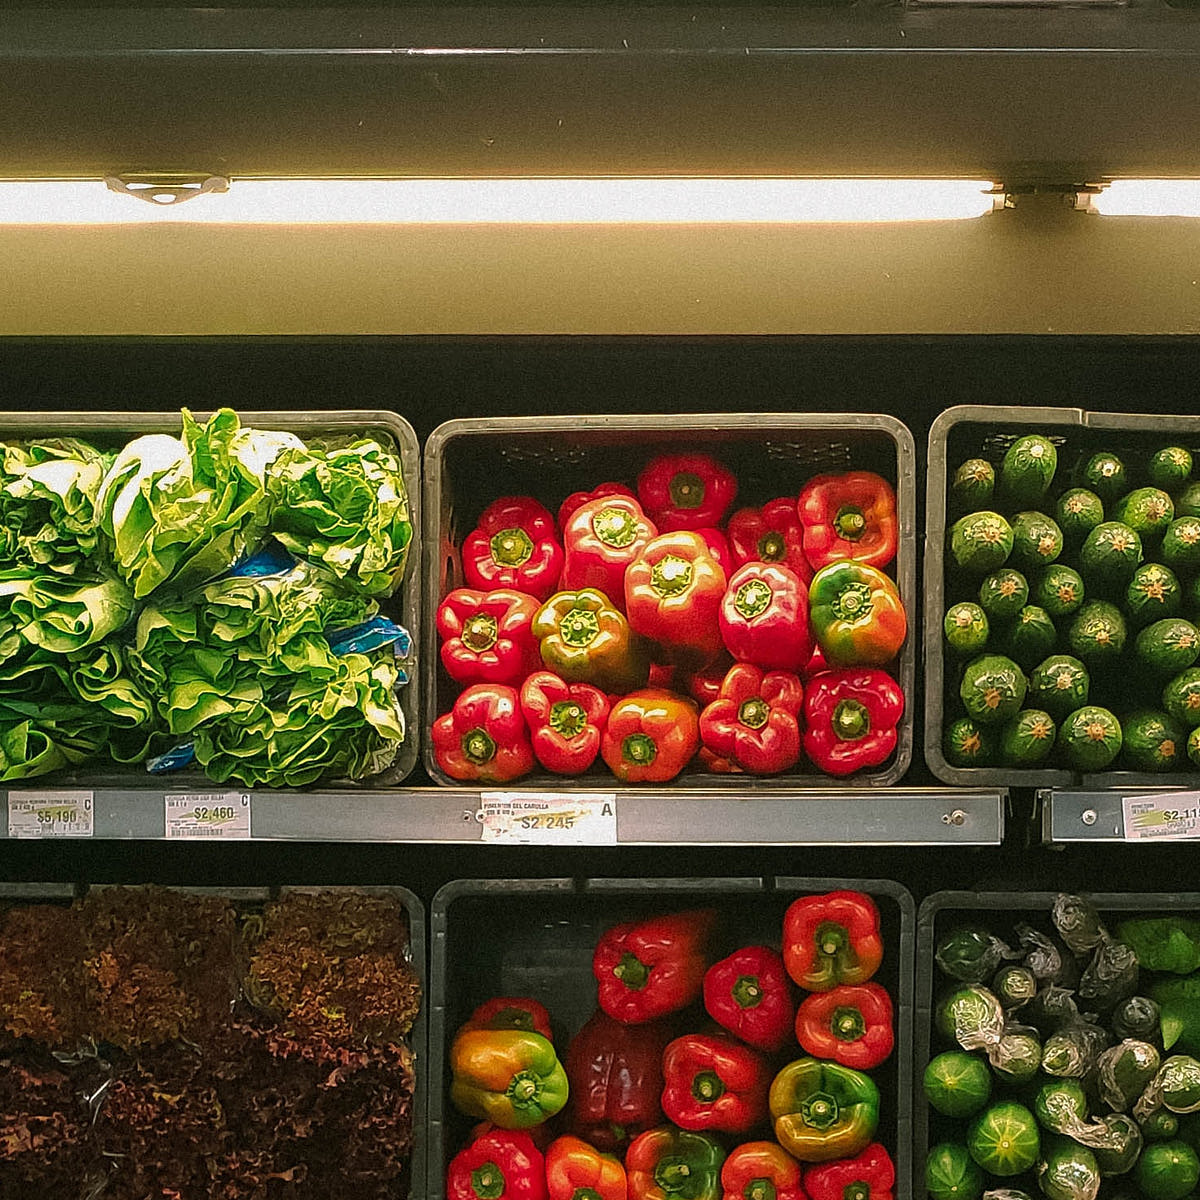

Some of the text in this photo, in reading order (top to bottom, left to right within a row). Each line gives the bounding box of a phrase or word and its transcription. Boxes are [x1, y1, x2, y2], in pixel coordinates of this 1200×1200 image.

[84, 799, 91, 811] C
[242, 795, 248, 806] C
[194, 807, 234, 820] $2,460
[601, 803, 613, 816] A
[37, 811, 77, 824] $5,190
